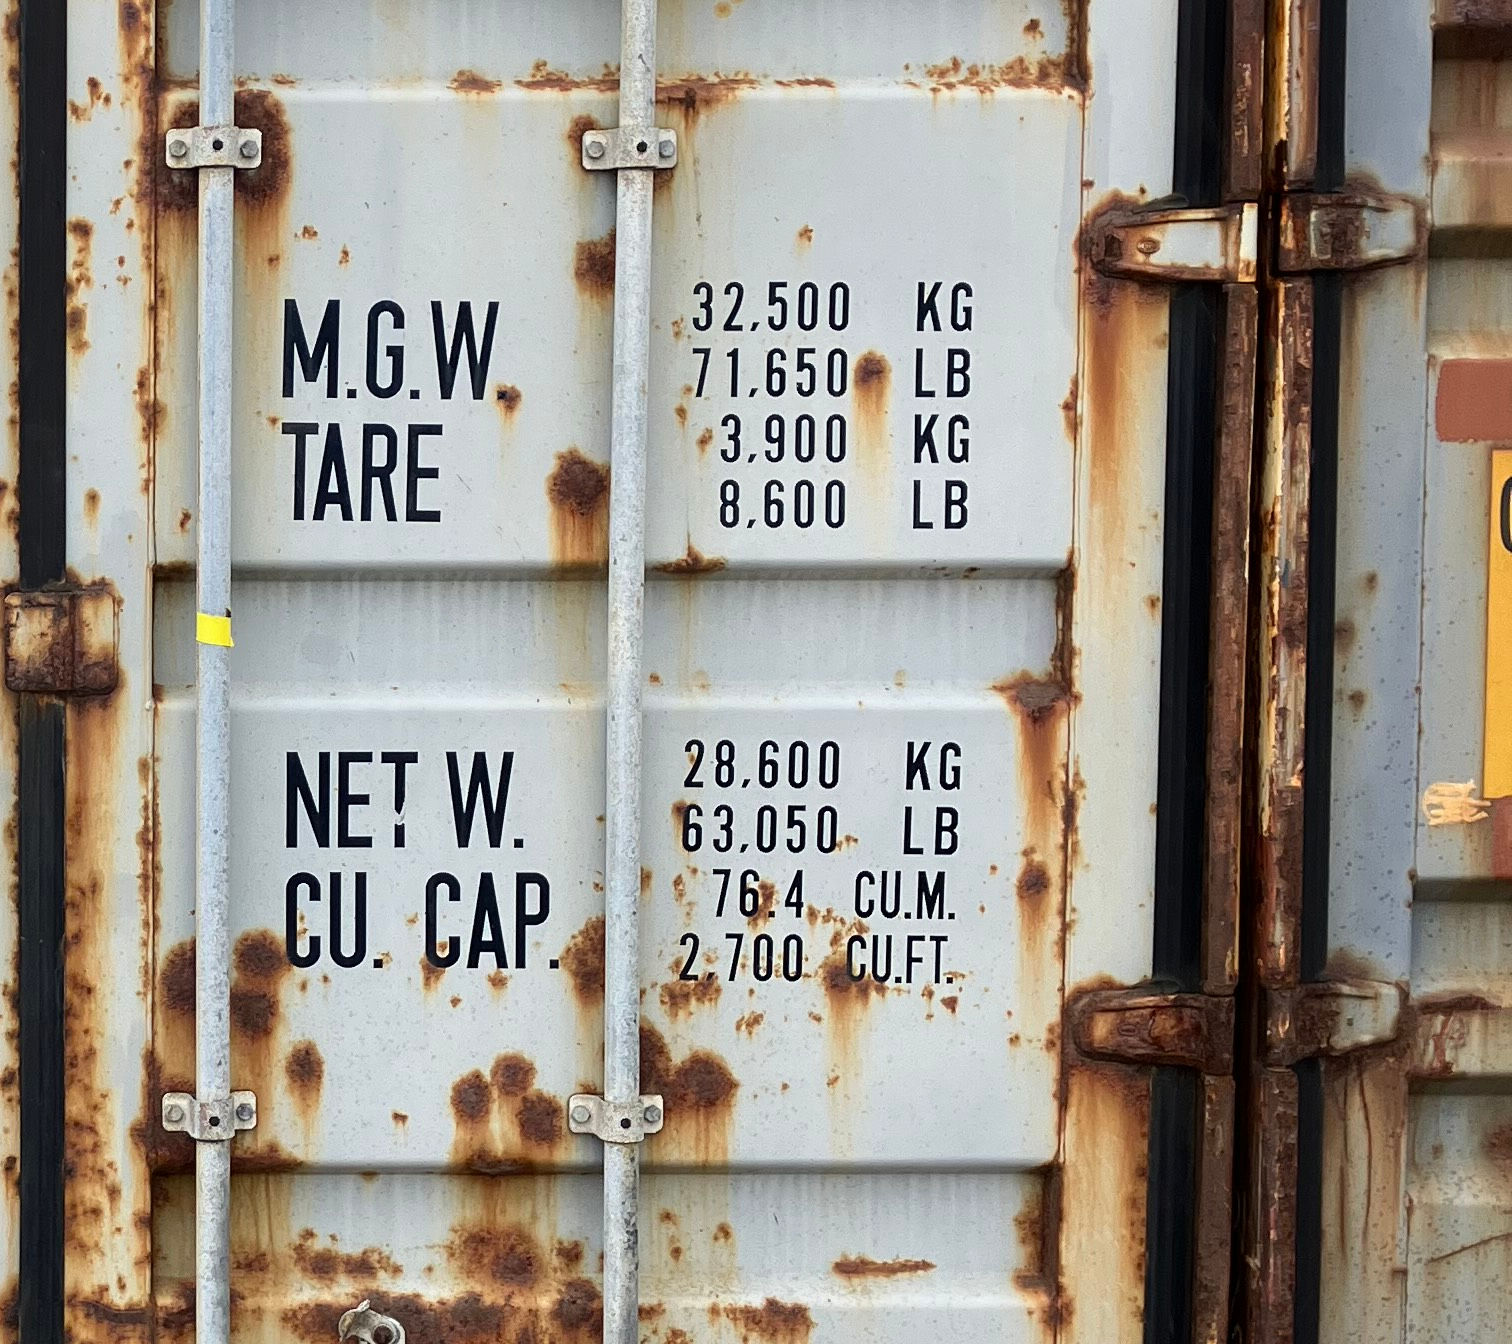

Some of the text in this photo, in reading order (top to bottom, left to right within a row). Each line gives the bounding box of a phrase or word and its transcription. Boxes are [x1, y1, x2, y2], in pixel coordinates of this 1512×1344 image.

[692, 282, 973, 333] 32,500 KG
[282, 299, 508, 402] M.G.W.
[692, 348, 972, 400] 71,650 LB
[720, 413, 971, 466] 3,900 KG
[281, 423, 443, 523] TARE
[718, 480, 969, 532] 8,600 LB
[684, 740, 962, 792] 28,600 KG
[285, 751, 525, 850] NET W.
[682, 805, 959, 857] 63,050 LB
[711, 868, 957, 921] 76.4 CU.M.
[285, 871, 561, 971] CU. CAP.
[679, 933, 956, 985] 2,700 CU.FT.
